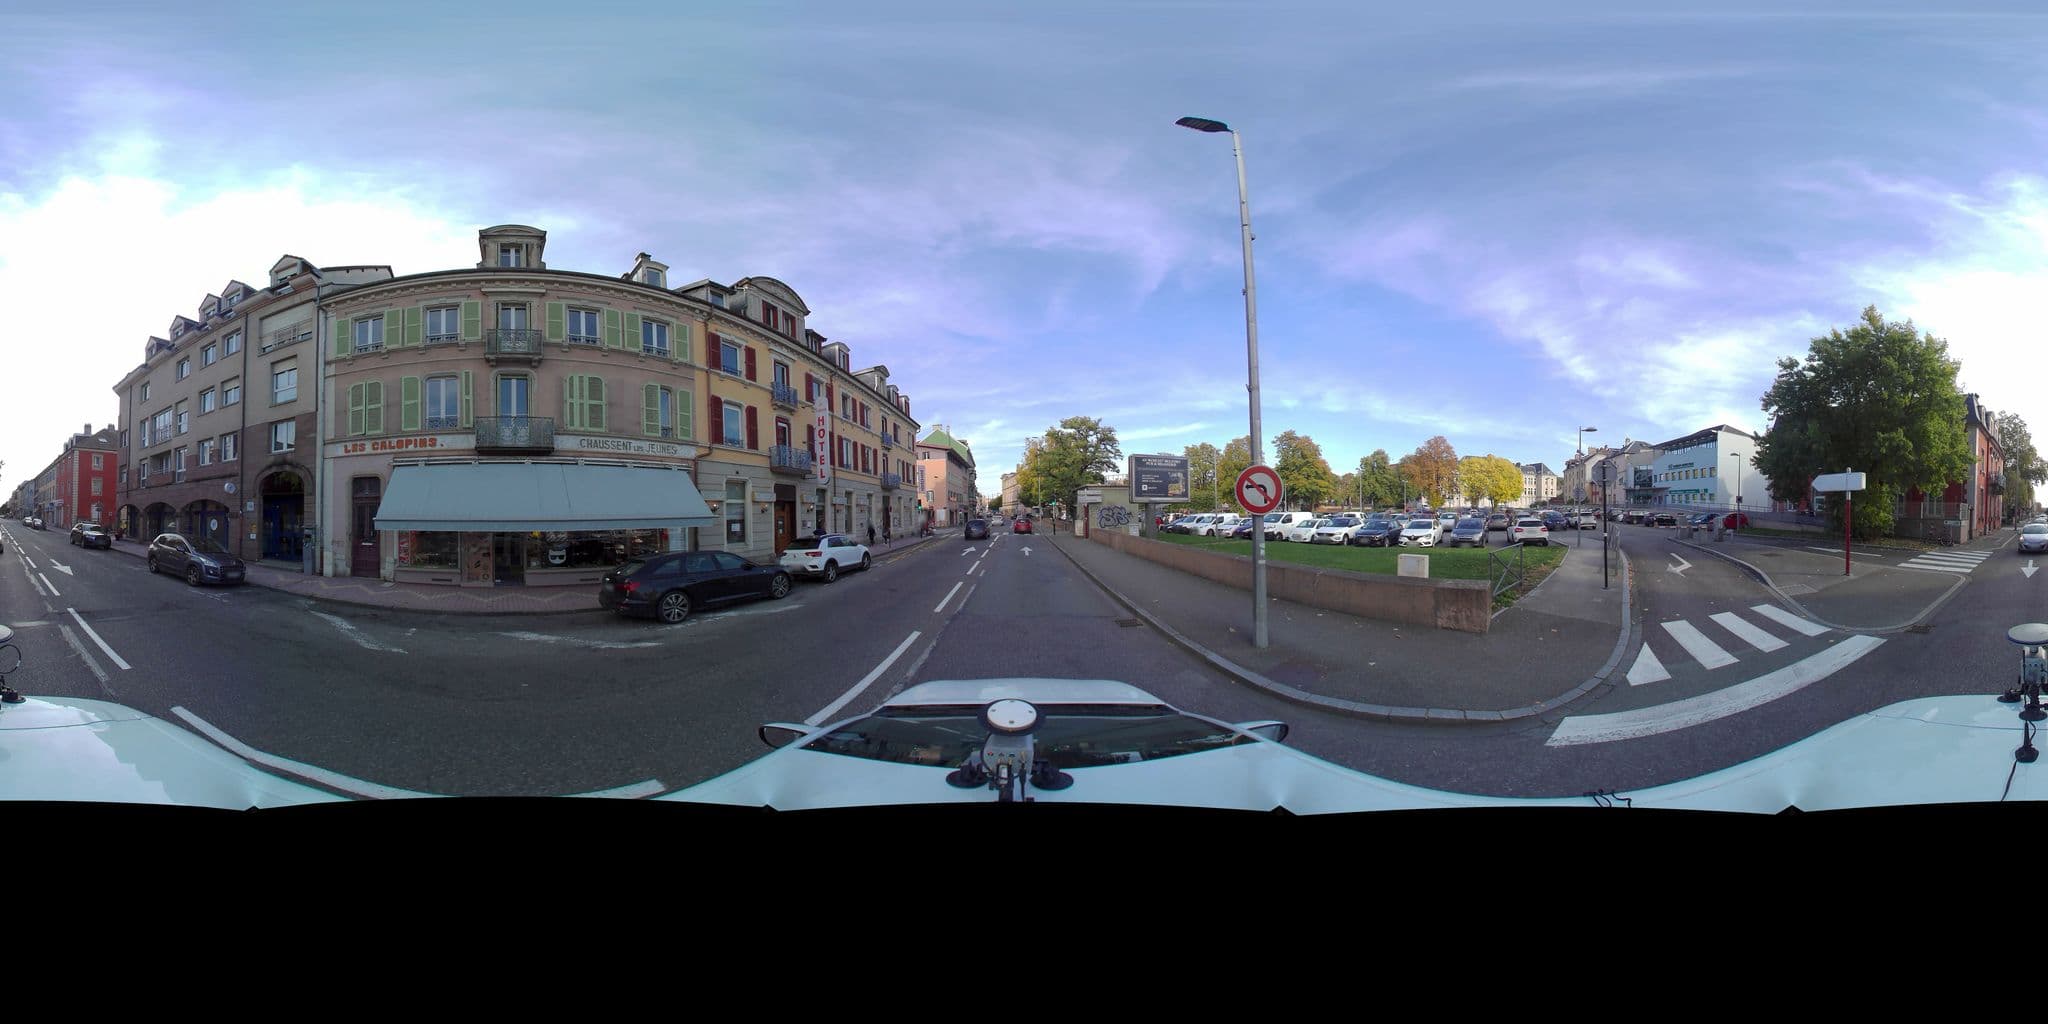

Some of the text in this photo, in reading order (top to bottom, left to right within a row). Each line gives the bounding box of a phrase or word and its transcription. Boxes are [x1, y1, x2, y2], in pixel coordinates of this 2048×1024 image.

[343, 443, 367, 454] LES
[580, 438, 633, 452] CHAUSSENT
[645, 442, 678, 455] JEUNES
[817, 415, 826, 479] HOTEL
